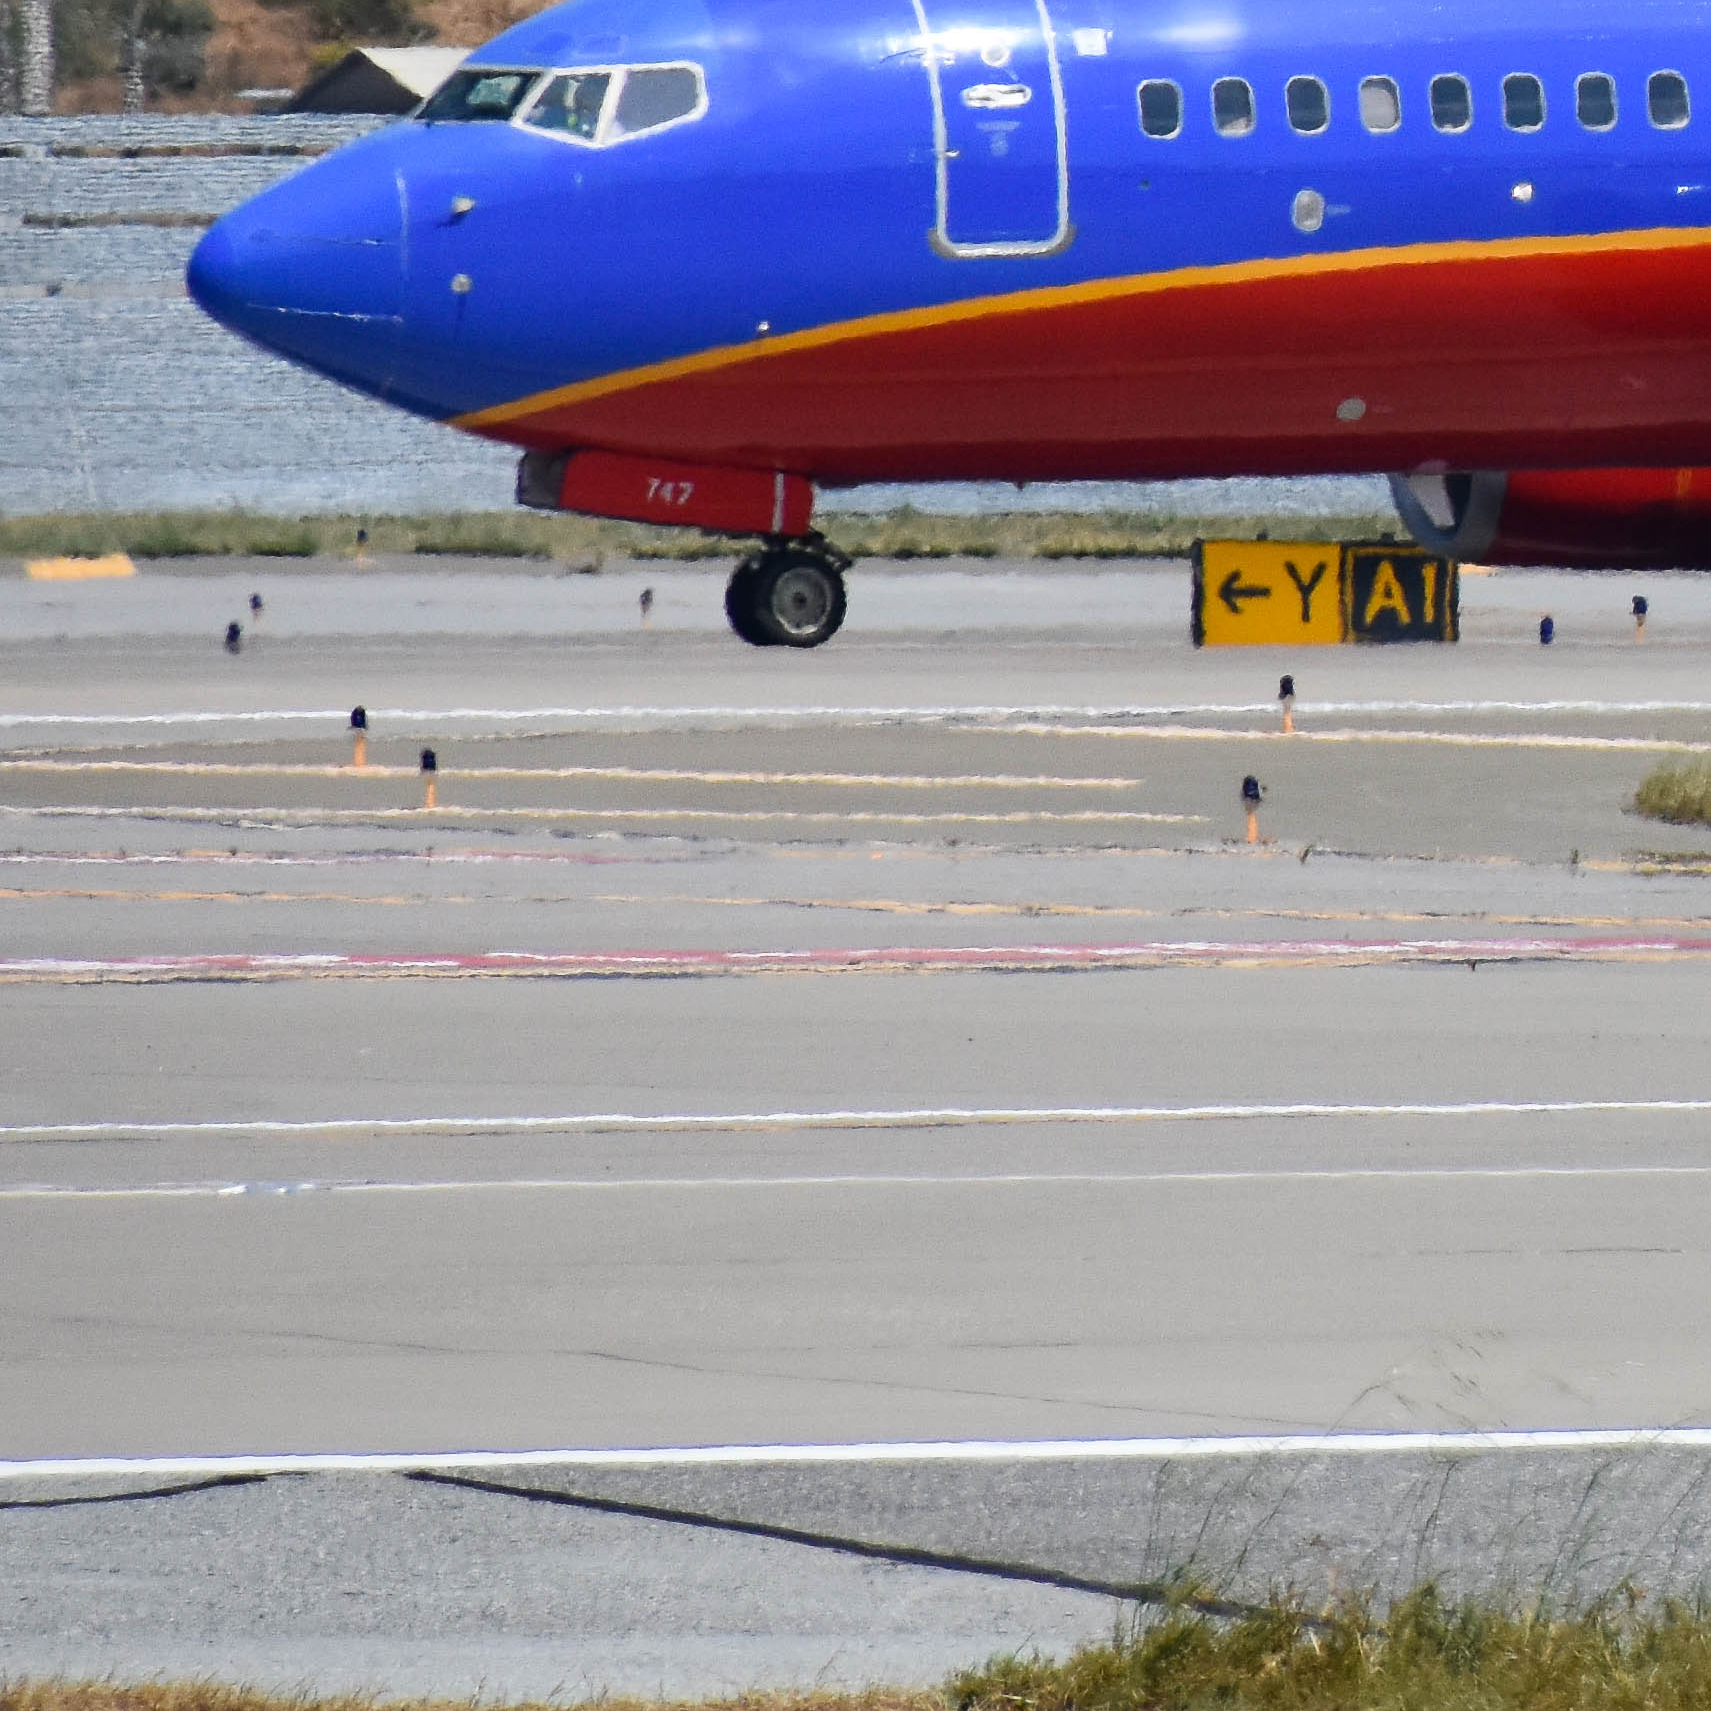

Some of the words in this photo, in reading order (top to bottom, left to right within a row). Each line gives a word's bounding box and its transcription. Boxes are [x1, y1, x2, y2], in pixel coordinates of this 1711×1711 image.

[647, 476, 696, 505] 747
[1284, 560, 1327, 623] Y
[1364, 559, 1438, 625] A1
